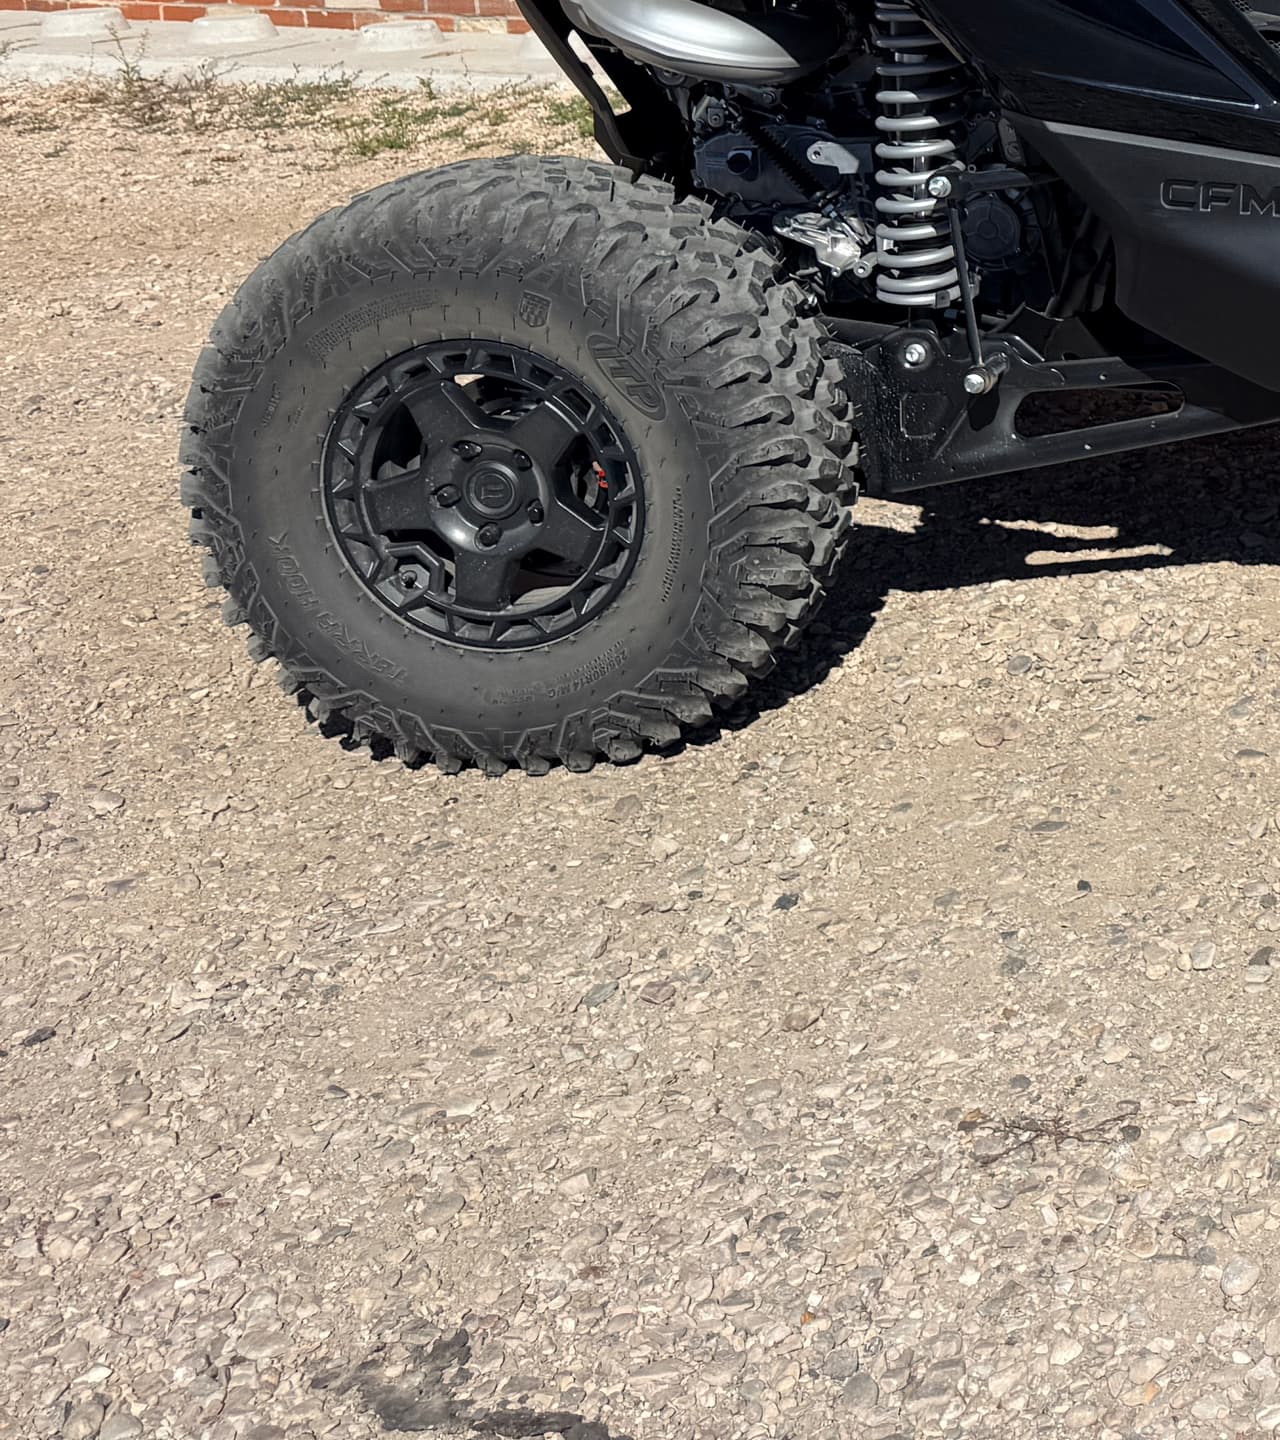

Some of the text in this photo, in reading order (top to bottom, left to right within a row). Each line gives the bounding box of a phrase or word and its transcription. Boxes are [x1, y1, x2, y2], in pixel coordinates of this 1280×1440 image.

[590, 342, 661, 413] ITP
[268, 532, 407, 683] TERRA HOOK
